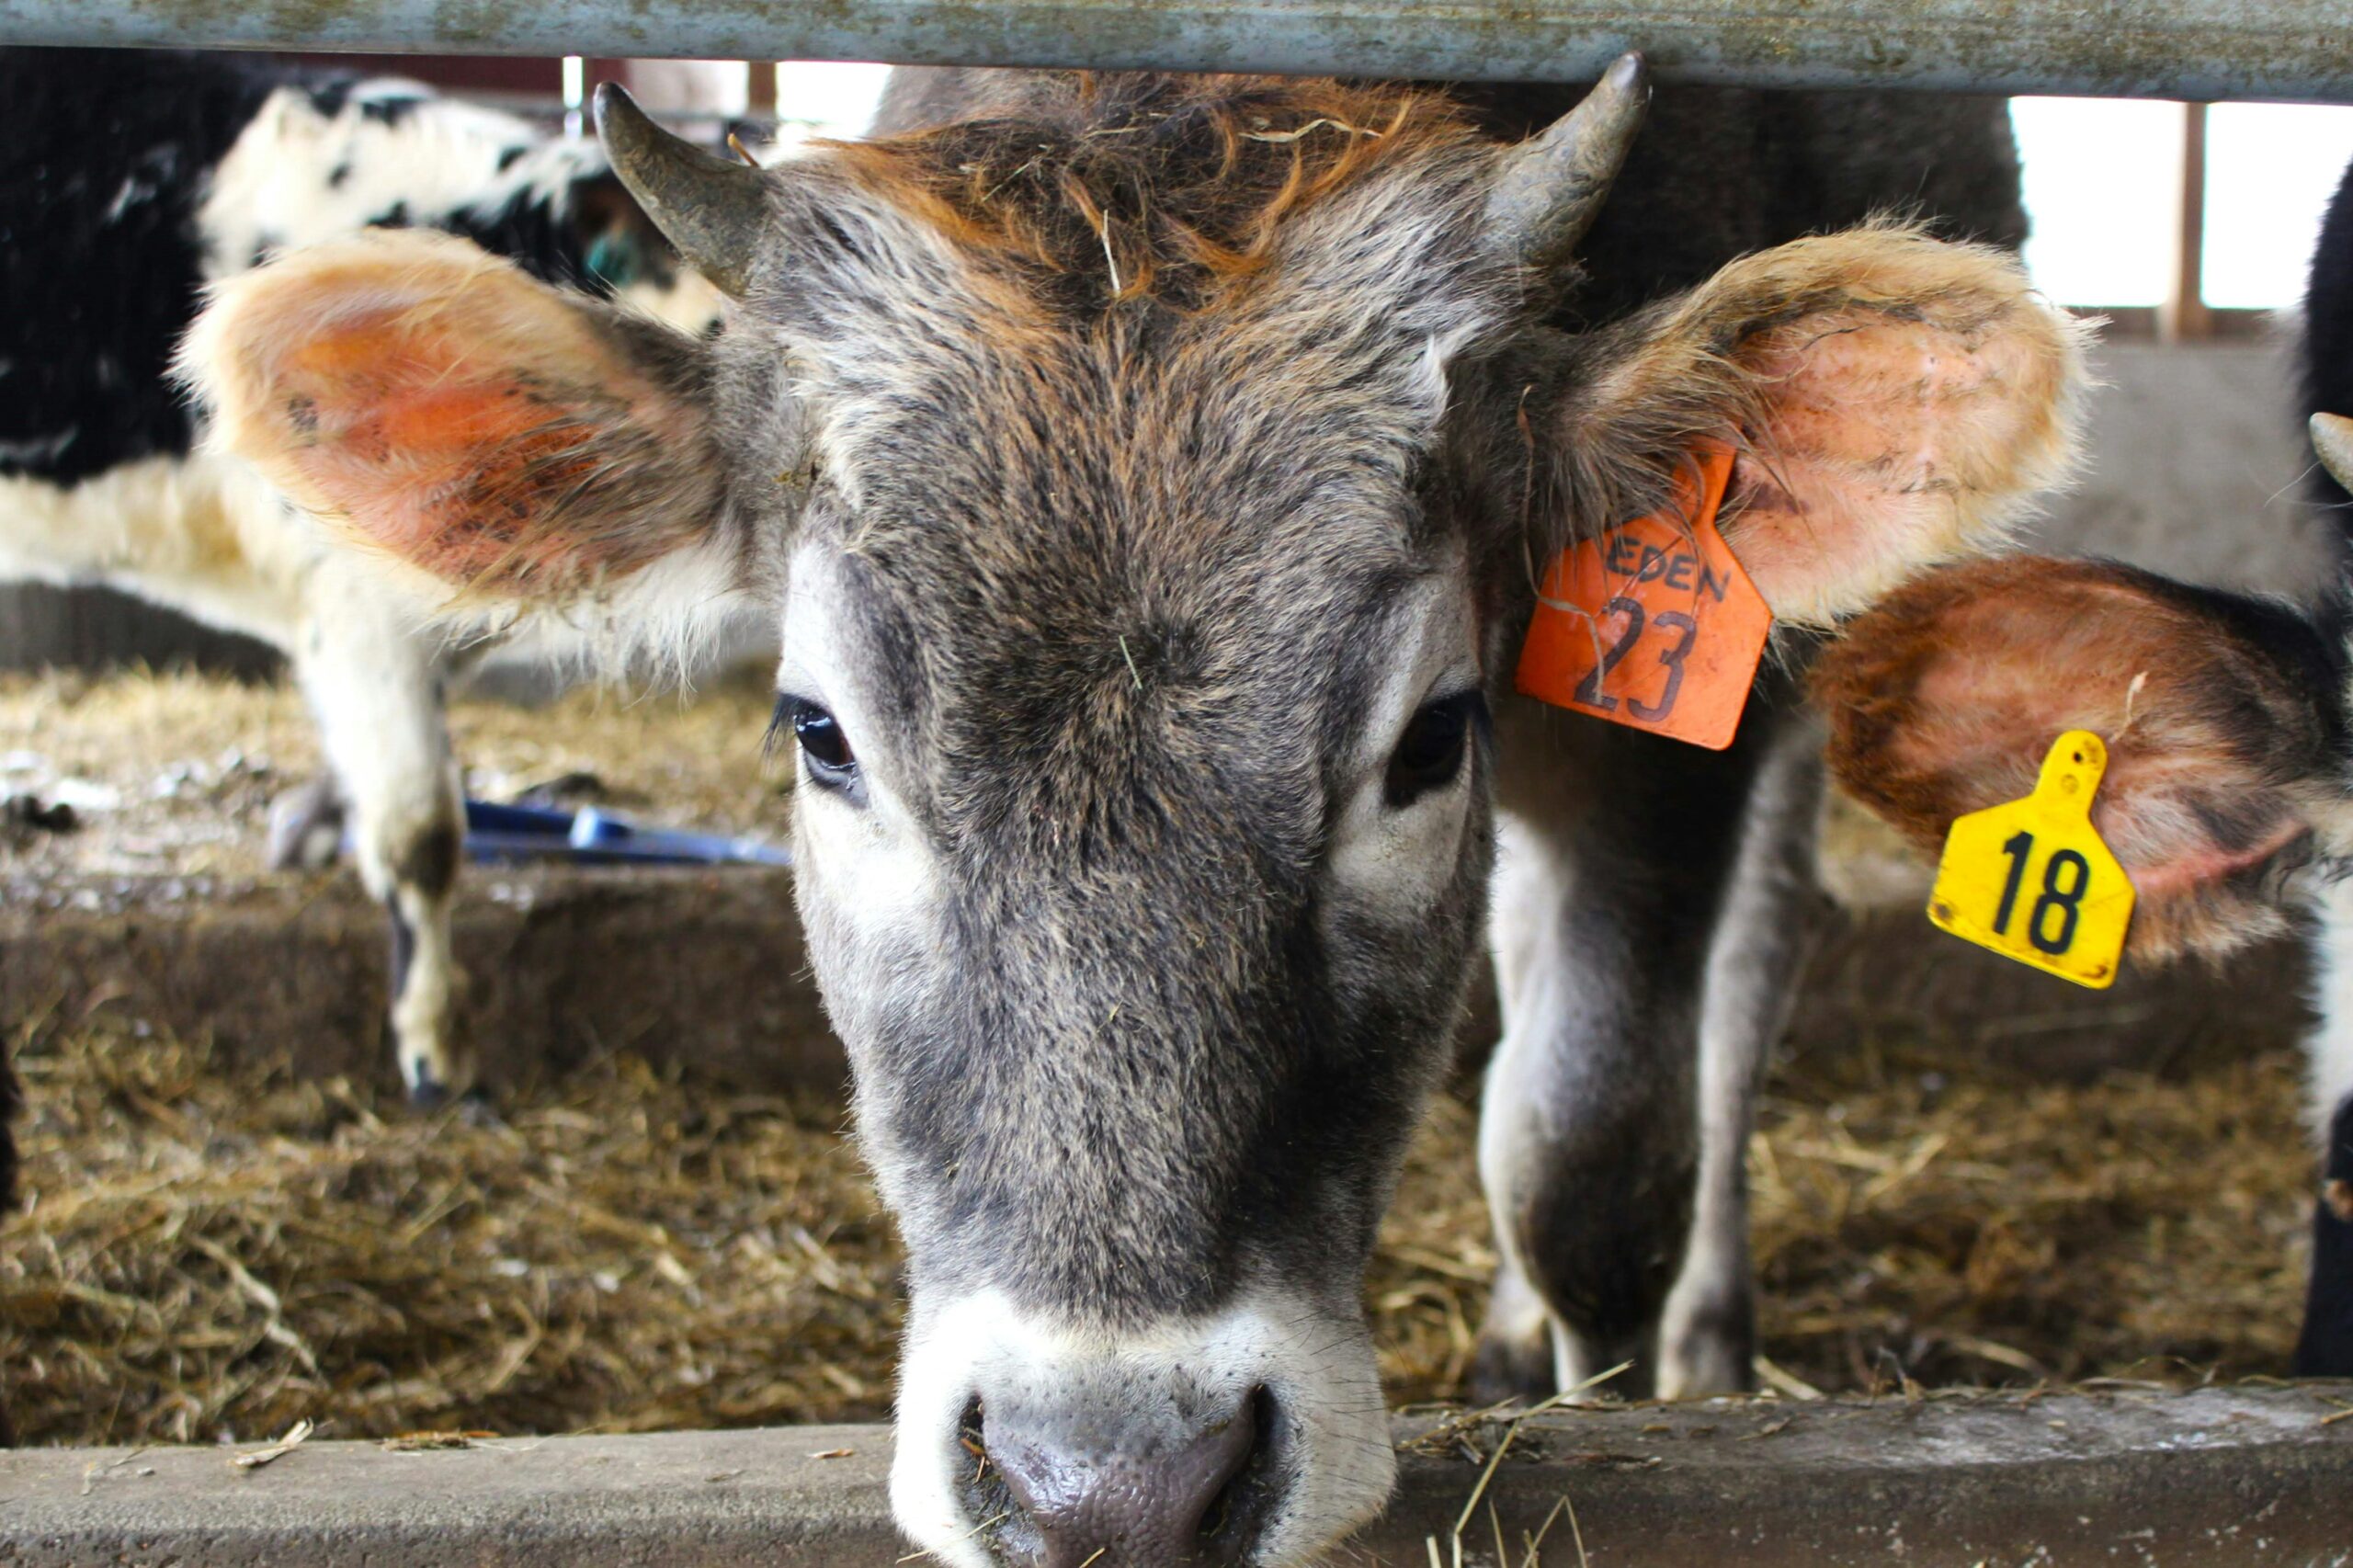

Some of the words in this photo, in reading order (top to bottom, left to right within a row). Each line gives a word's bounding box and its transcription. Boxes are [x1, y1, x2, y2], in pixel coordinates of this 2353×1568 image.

[1605, 536, 1731, 602] EDEN
[1574, 597, 1698, 722] 23
[1993, 830, 2090, 955] 18
